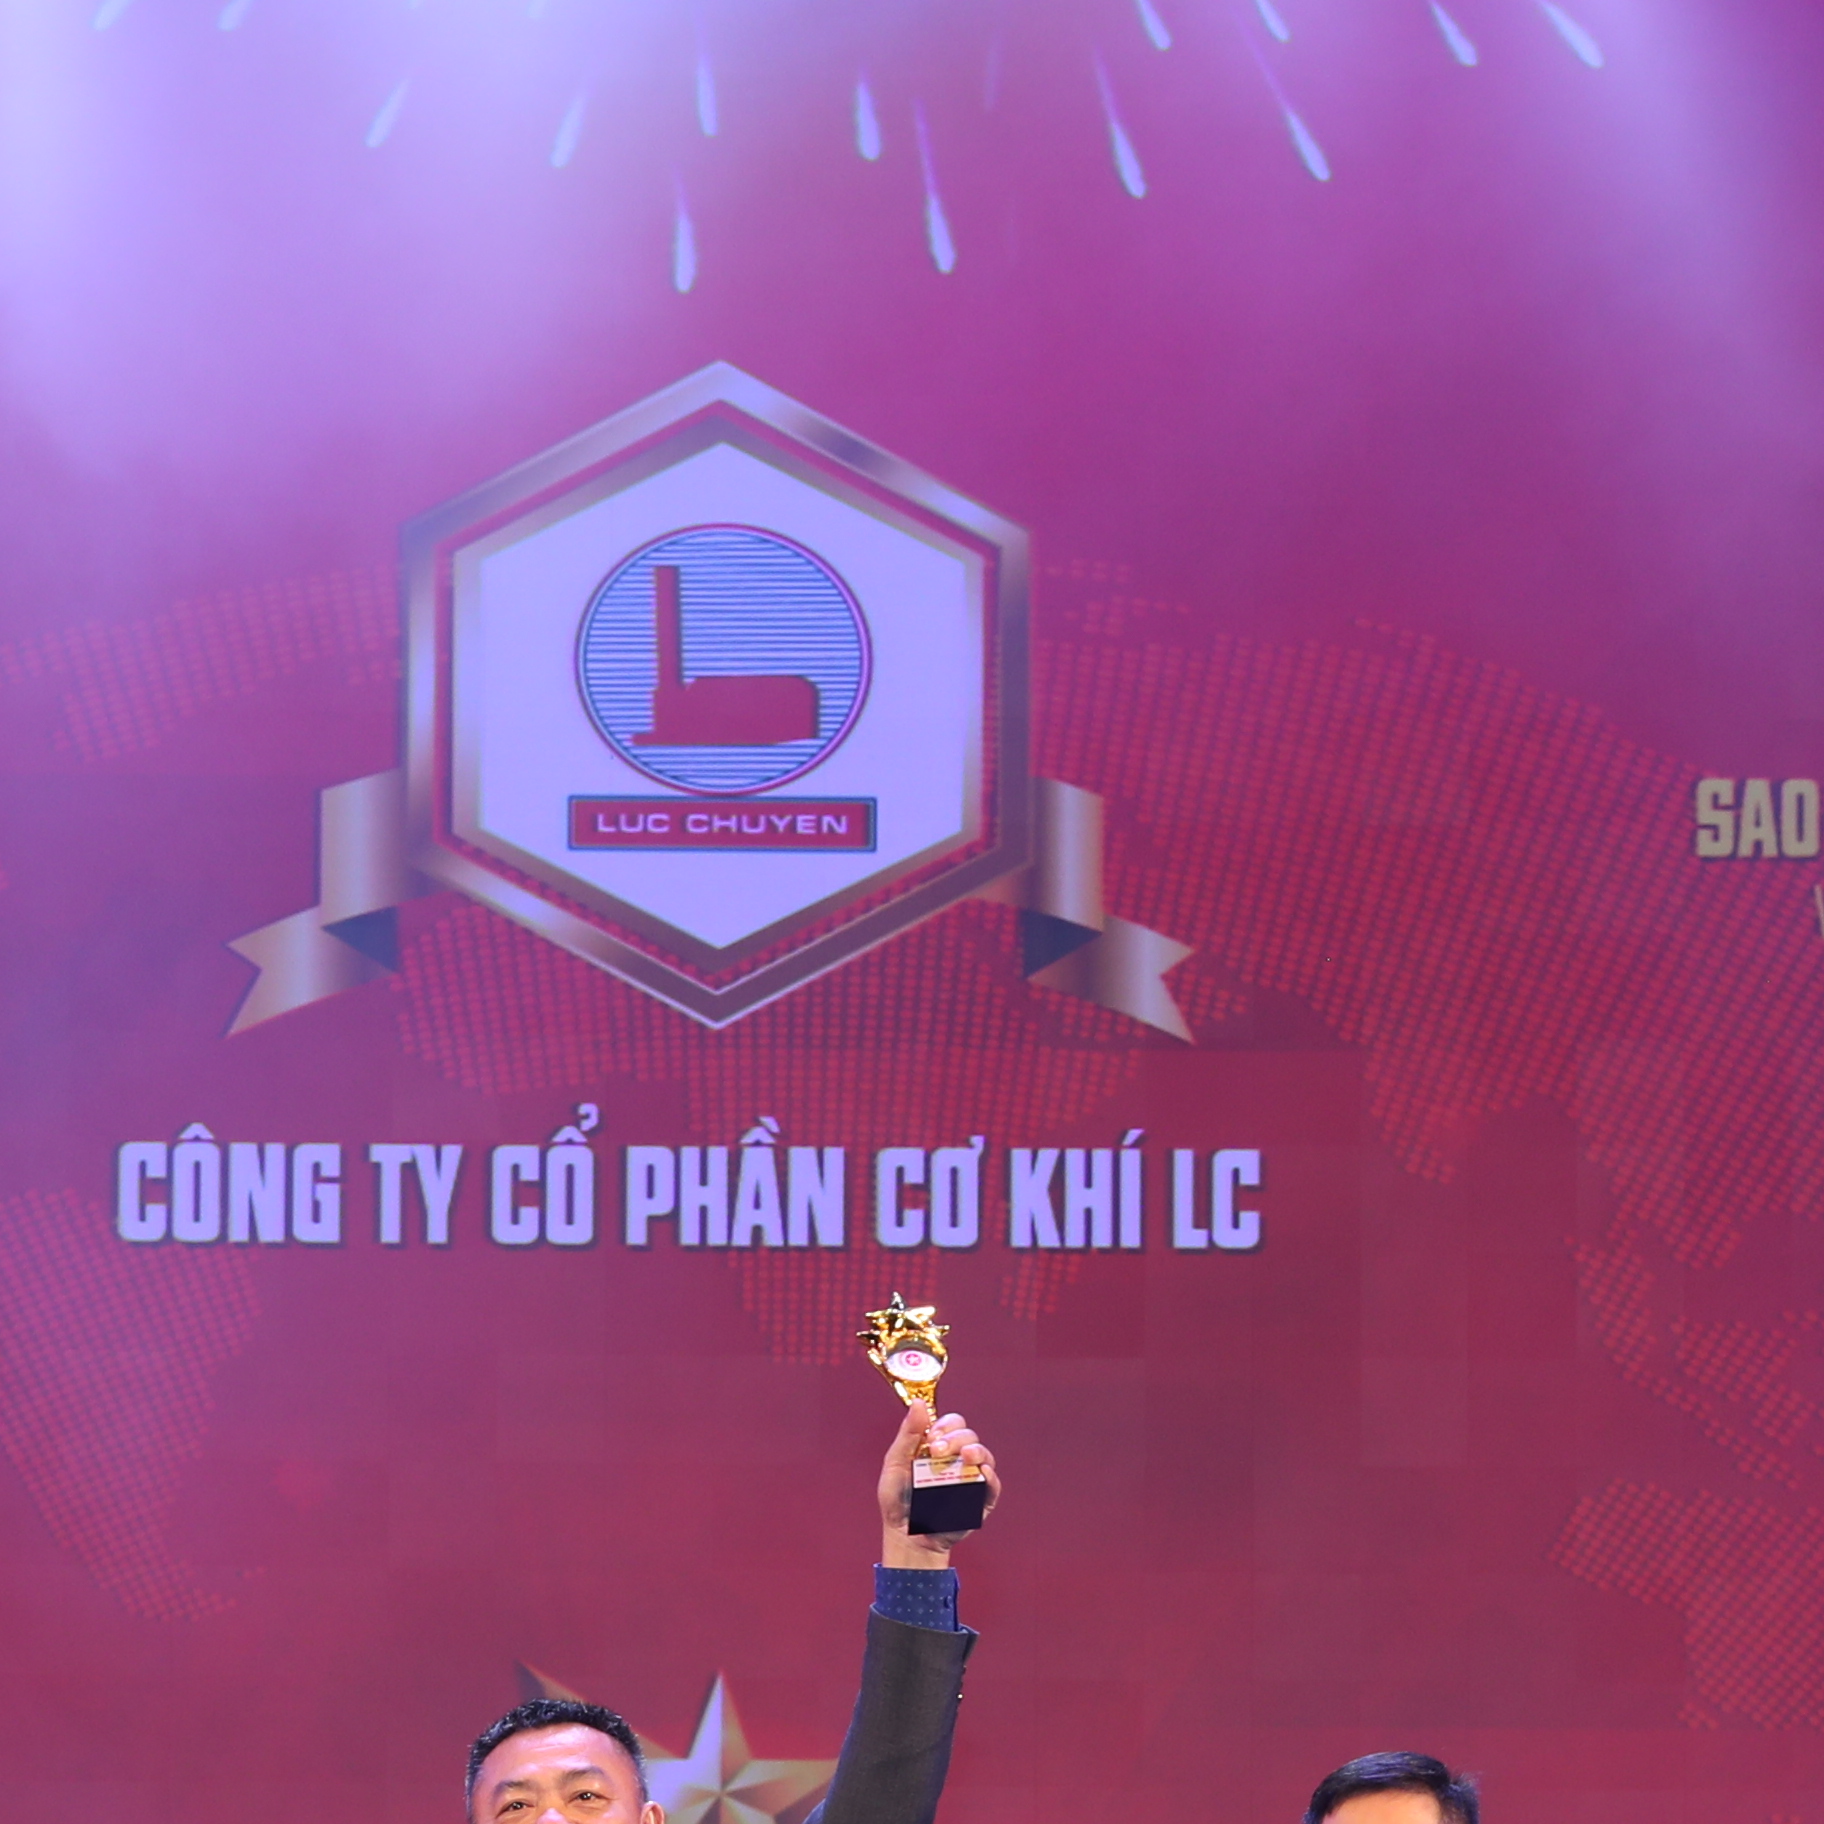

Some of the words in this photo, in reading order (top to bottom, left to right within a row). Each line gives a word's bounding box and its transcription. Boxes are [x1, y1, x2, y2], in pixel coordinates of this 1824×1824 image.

[596, 812, 671, 834] LUC
[686, 812, 849, 836] CHUYEN
[1695, 778, 1820, 858] SAO
[117, 1122, 343, 1243] CÔNG
[369, 1143, 464, 1244] TY
[491, 1103, 601, 1246] CỔ
[625, 1115, 845, 1247] PHẦN
[876, 1134, 986, 1249] CƠ
[1009, 1128, 1146, 1249] KHÍ
[1173, 1147, 1261, 1250] LC
